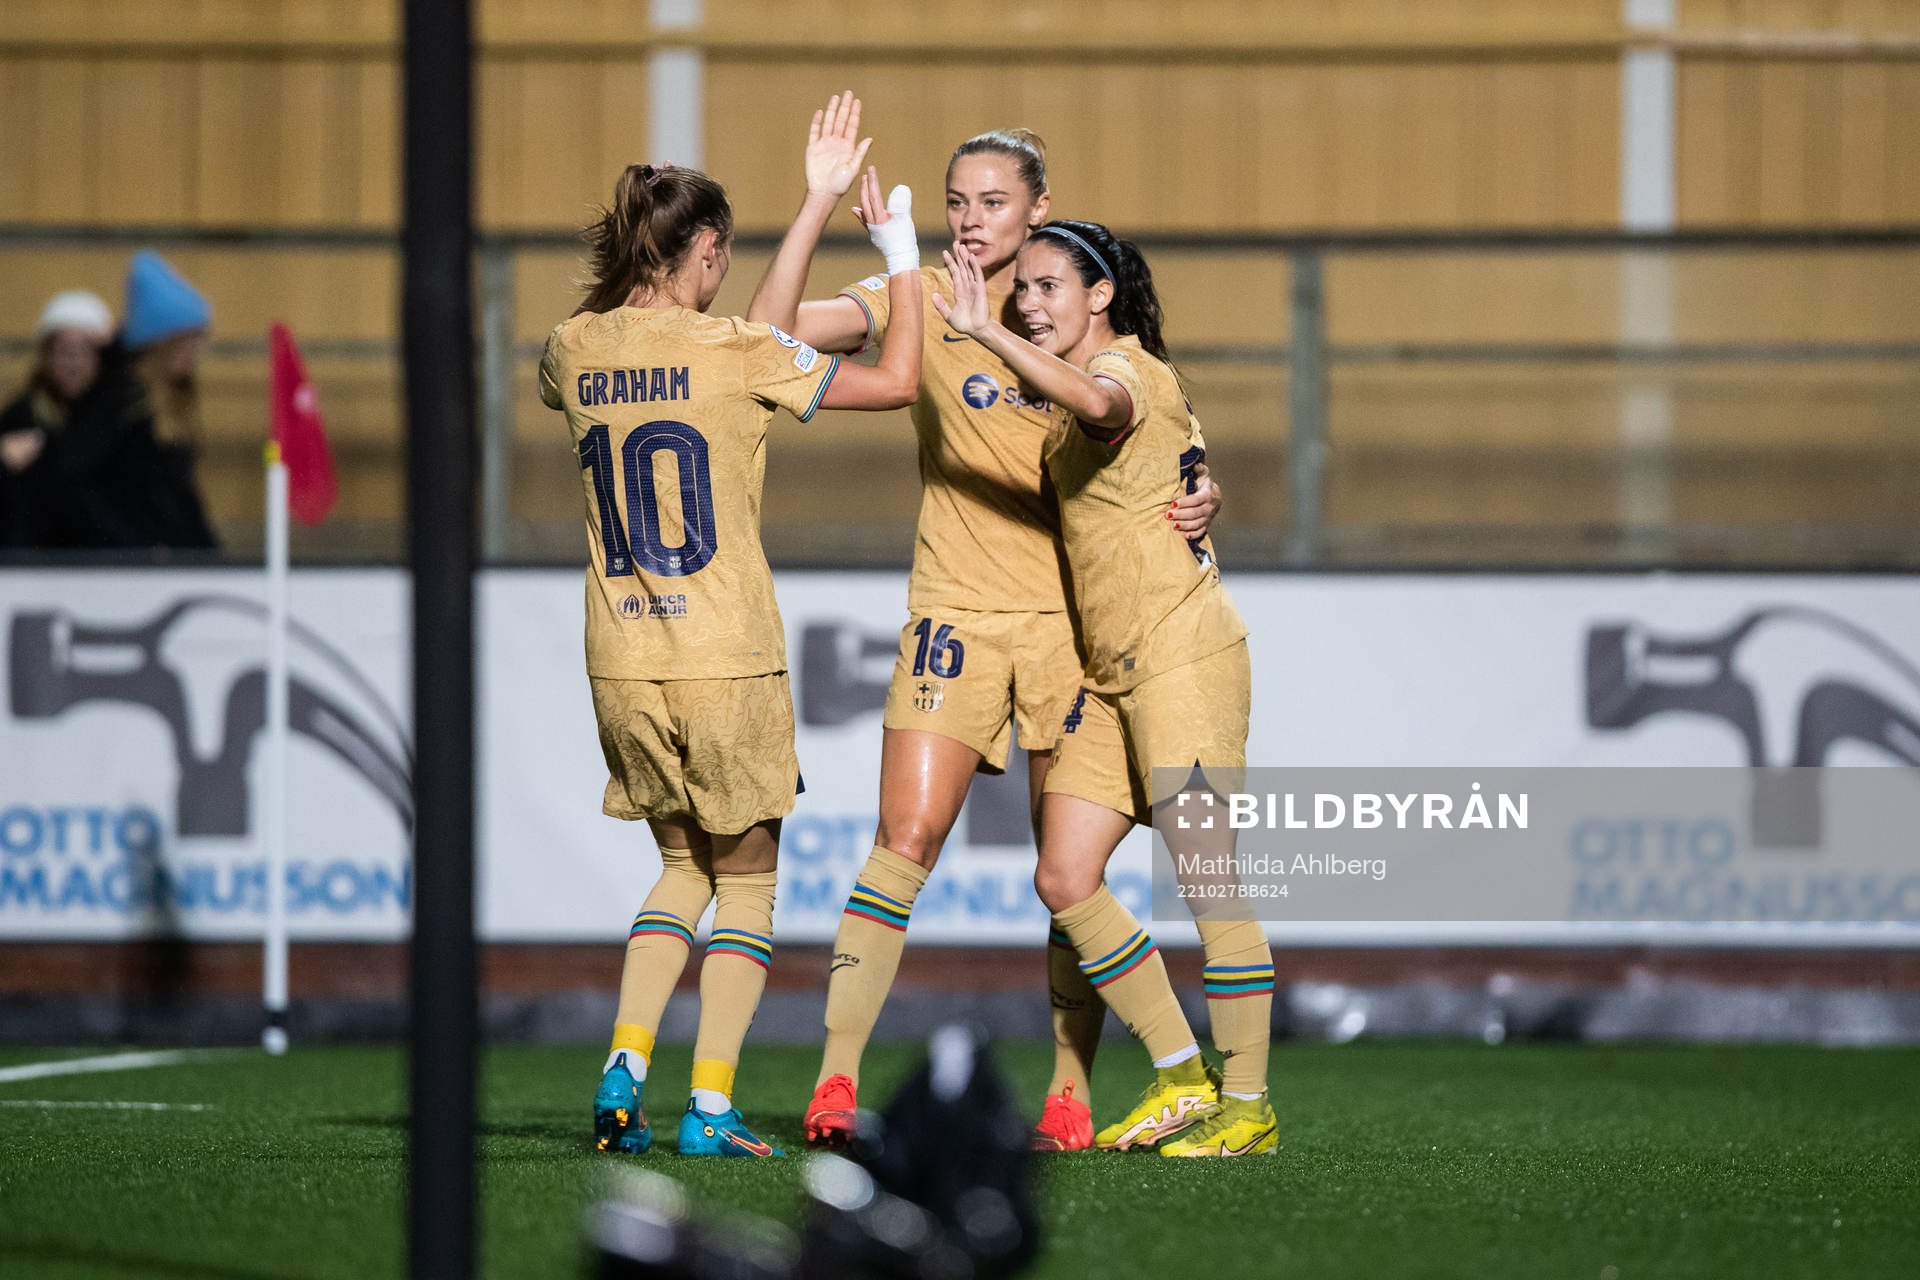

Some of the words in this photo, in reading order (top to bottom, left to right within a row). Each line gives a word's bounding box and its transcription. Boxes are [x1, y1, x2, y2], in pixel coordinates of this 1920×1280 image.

[578, 366, 690, 406] GRAHAM
[579, 420, 718, 577] 10
[912, 617, 965, 679] 16
[0, 807, 160, 854] OTTO
[1567, 815, 1736, 866] OTTO
